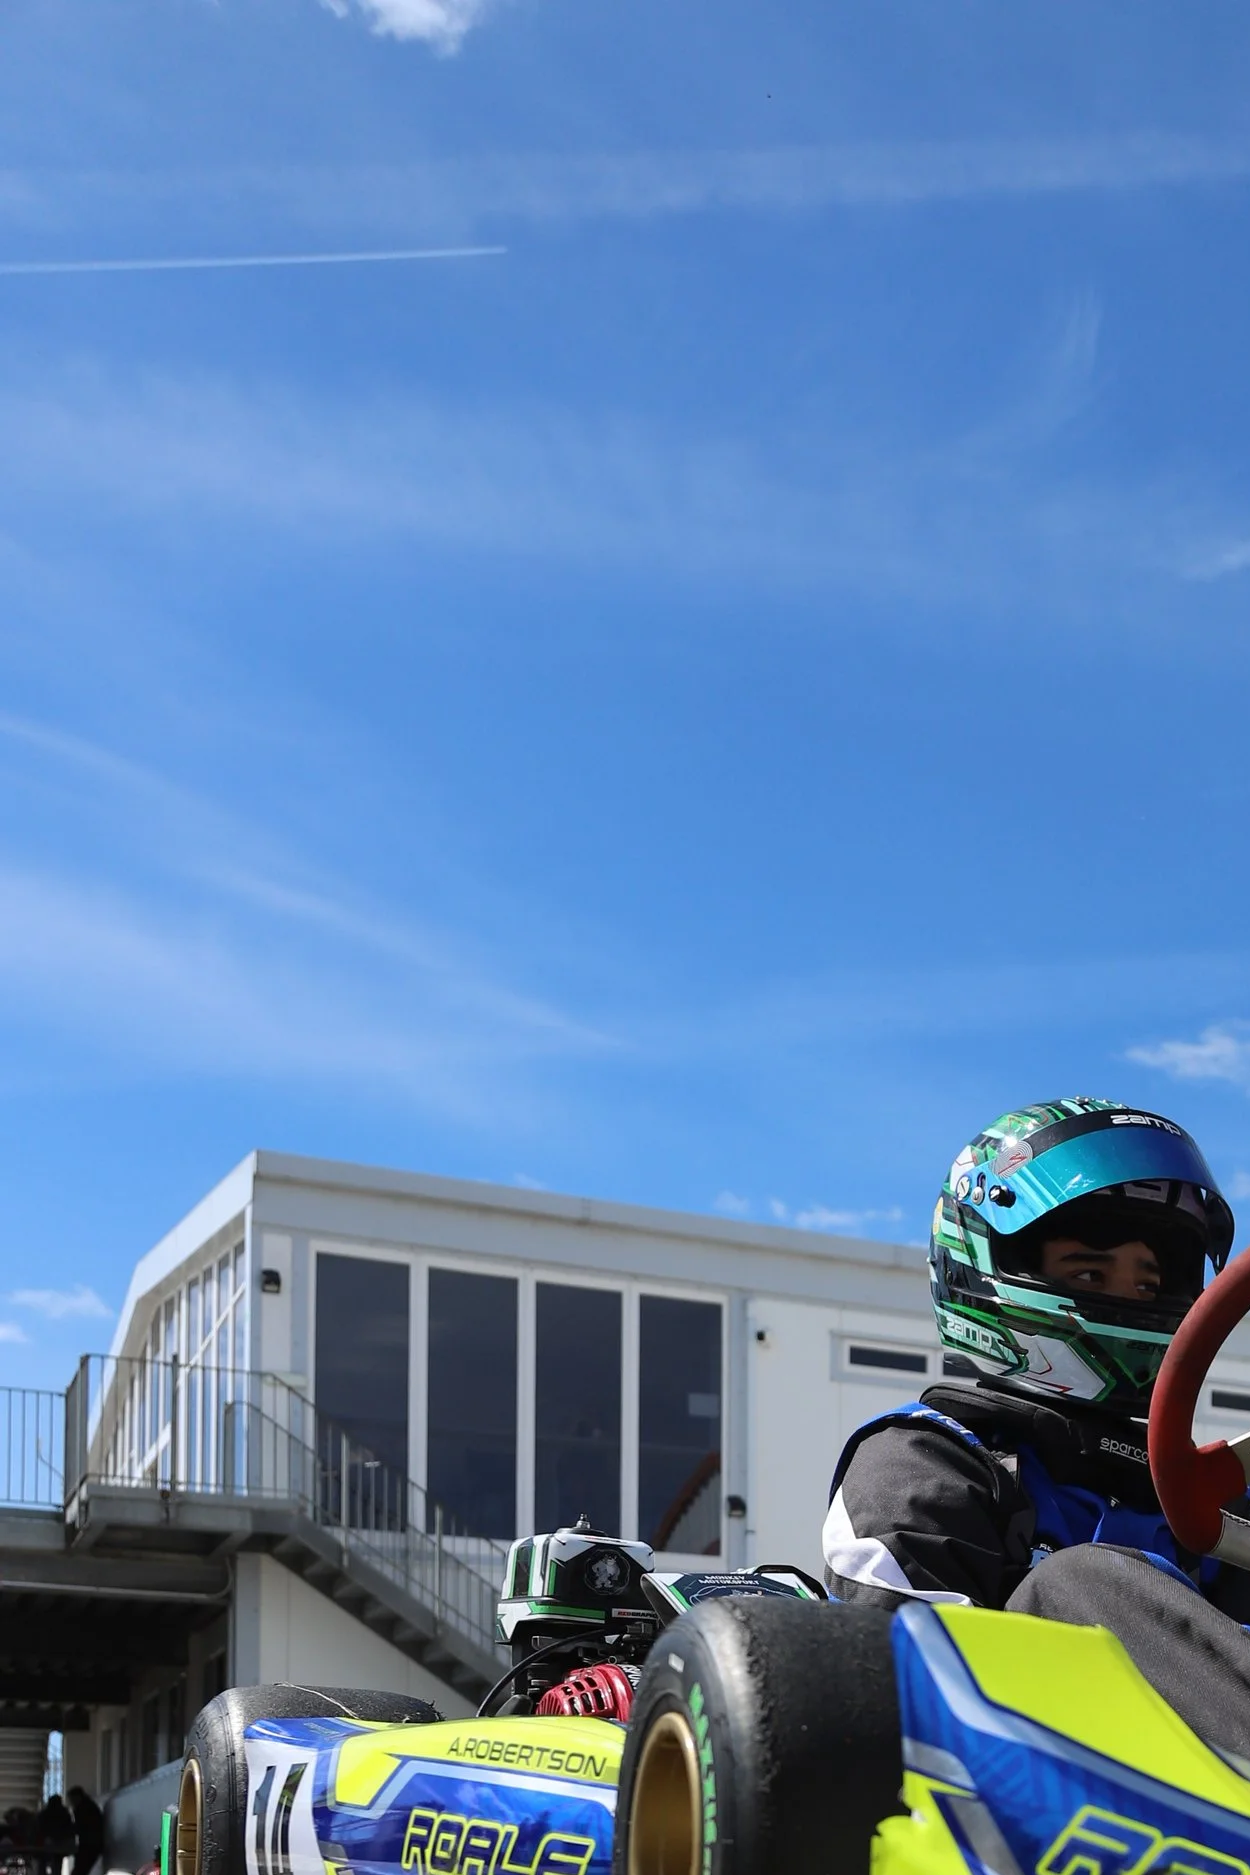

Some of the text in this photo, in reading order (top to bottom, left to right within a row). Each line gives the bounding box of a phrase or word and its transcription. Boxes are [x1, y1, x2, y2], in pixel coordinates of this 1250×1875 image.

[1110, 1114, 1181, 1136] zamp
[946, 1317, 993, 1353] zamp
[1100, 1437, 1149, 1461] sparco
[448, 1738, 606, 1778] A.ROBERTSON
